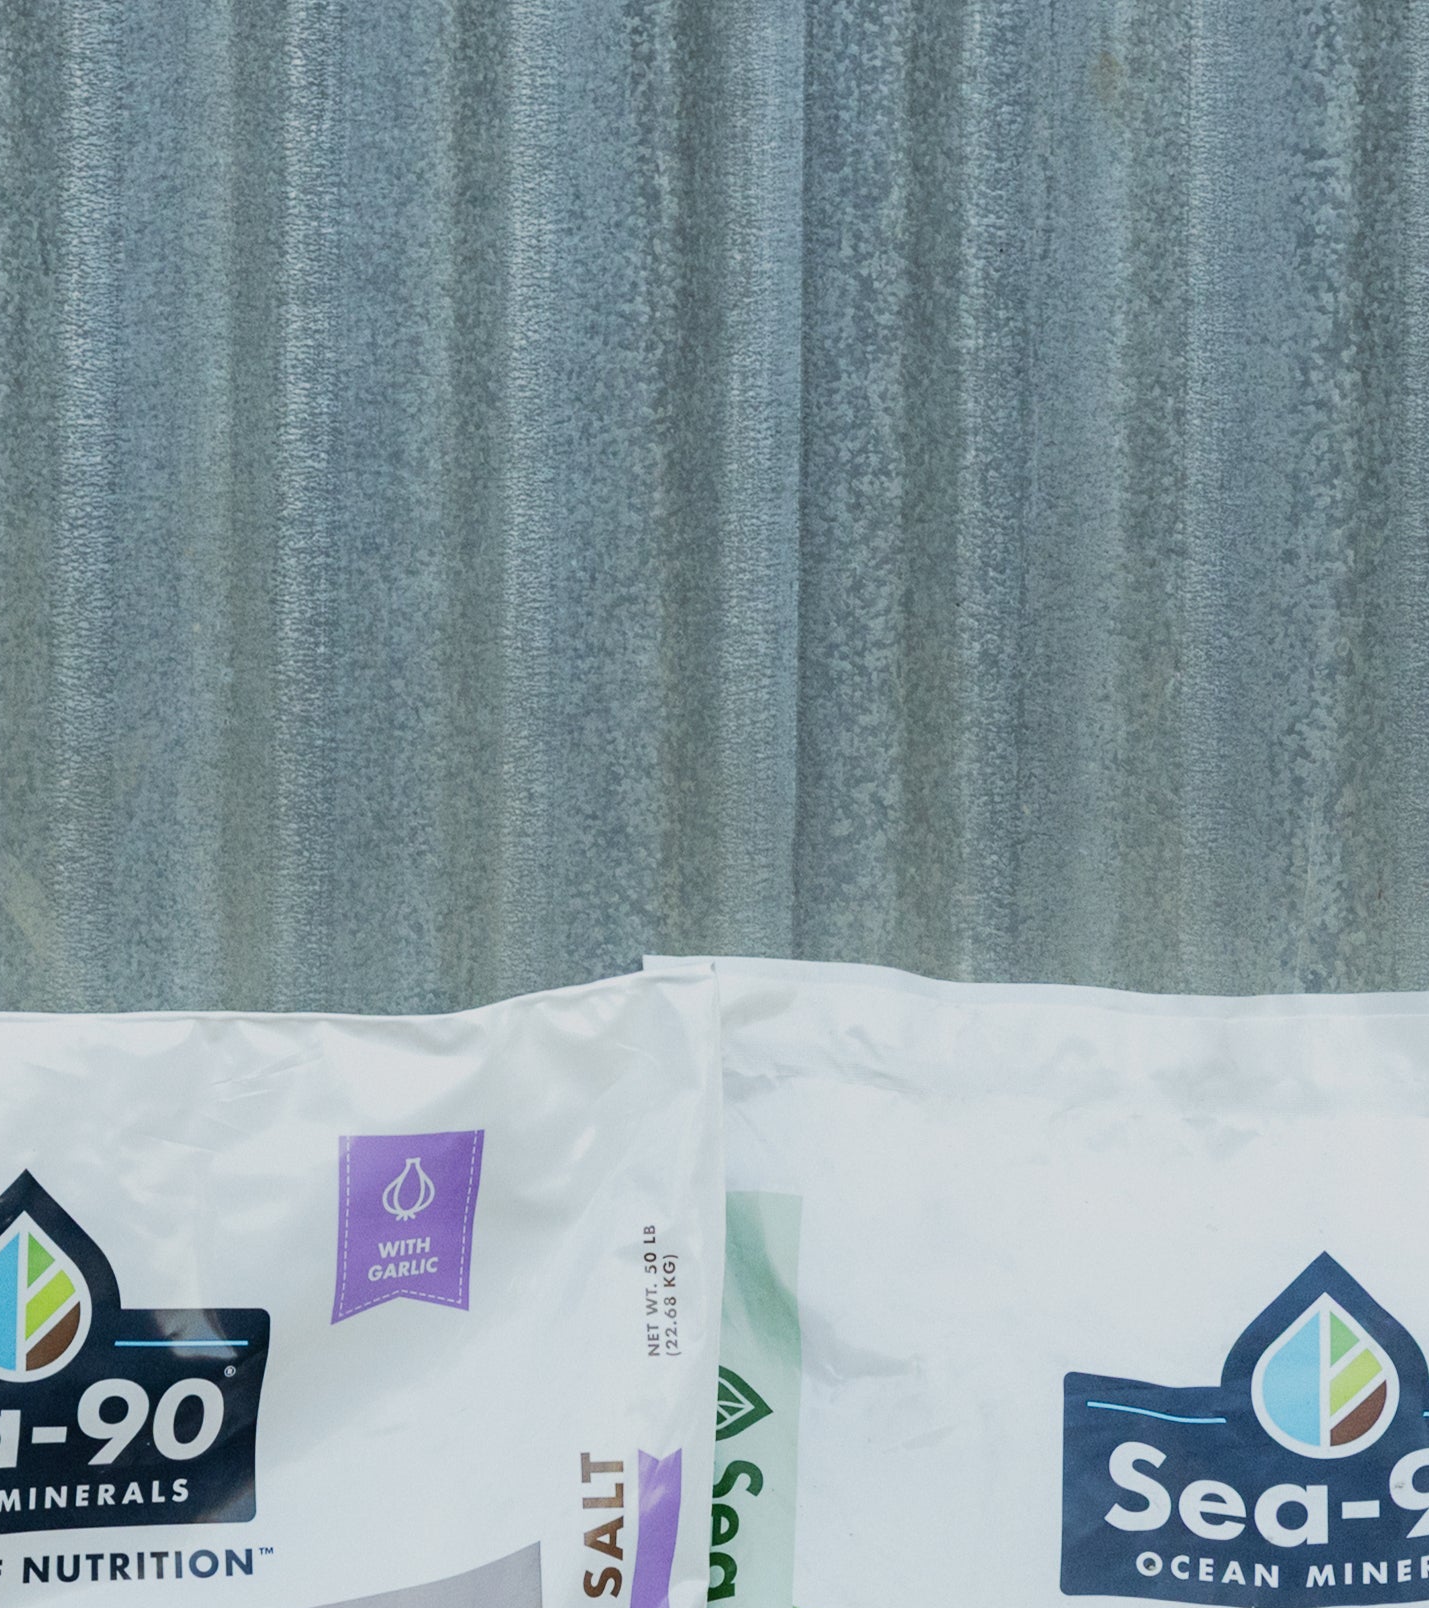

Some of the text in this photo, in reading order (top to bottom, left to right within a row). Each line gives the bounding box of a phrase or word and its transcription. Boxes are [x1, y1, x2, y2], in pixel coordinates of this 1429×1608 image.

[367, 1257, 438, 1282] GARLIC
[378, 1237, 431, 1259] WITH
[643, 1224, 660, 1357] NET WT. 50 LB
[662, 1254, 681, 1357] (22.68 KG)
[581, 1452, 624, 1598] SALT
[1135, 1551, 1280, 1589] OCEAN
